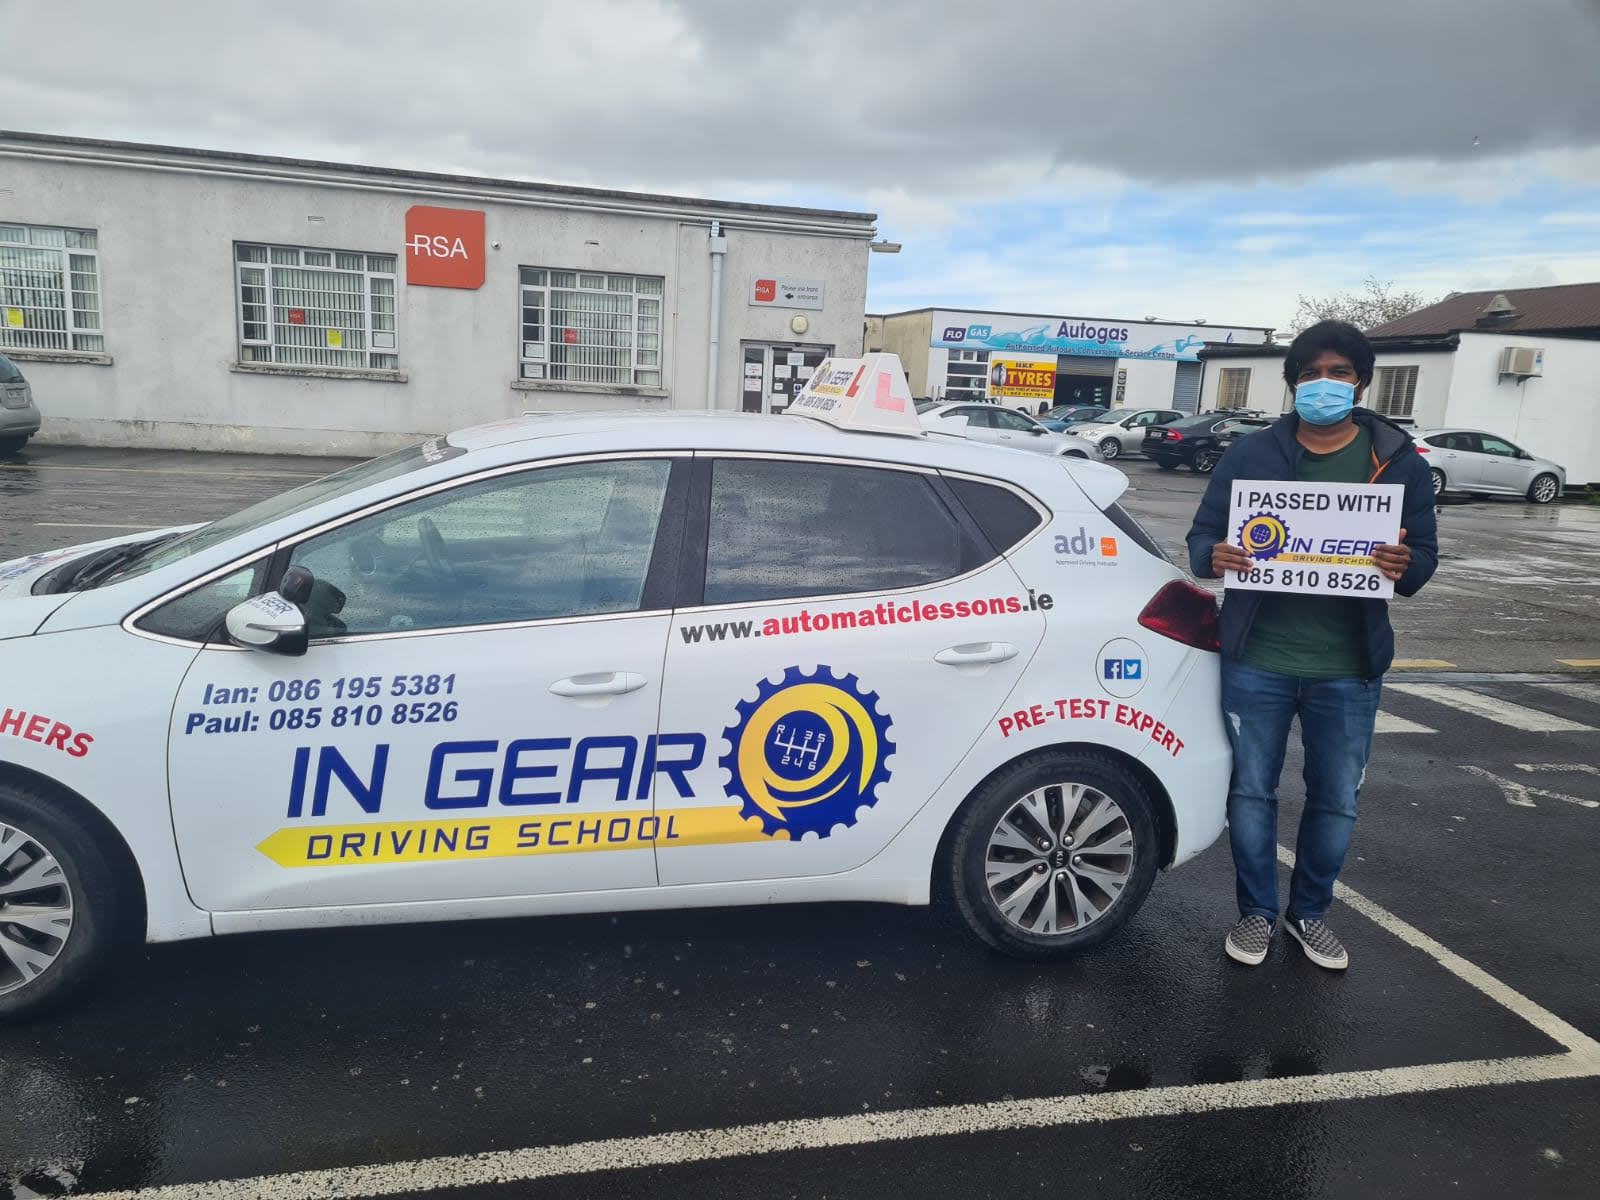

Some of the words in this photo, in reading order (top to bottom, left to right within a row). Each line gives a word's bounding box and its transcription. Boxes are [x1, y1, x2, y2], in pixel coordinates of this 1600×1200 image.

[411, 233, 469, 260] RSA
[945, 330, 963, 339] FLO
[969, 328, 989, 337] GAS
[1056, 320, 1129, 344] Autogas
[1005, 342, 1045, 352] Authorised
[1045, 344, 1075, 354] Autogas
[1077, 346, 1117, 356] Conversion
[1125, 349, 1151, 358] Service
[1152, 350, 1176, 359] Centre
[1007, 370, 1052, 387] TYRES
[874, 372, 905, 411] L
[1237, 491, 1242, 507] I
[1249, 491, 1330, 511] PASSED
[1337, 494, 1392, 513] WITH
[1290, 537, 1314, 553] IN
[1292, 554, 1332, 563] DRIVING
[1337, 557, 1377, 566] SCHOO
[1237, 567, 1275, 585] 085
[1281, 569, 1319, 588] 810
[1327, 572, 1381, 591] 8526
[680, 588, 1054, 644] www.automaticlessons.ie
[202, 683, 259, 705] Ian:
[268, 678, 322, 702] 086
[332, 676, 382, 699] 195
[390, 673, 456, 697] 5381
[185, 710, 260, 735] Paul:
[269, 707, 322, 731] 085
[330, 704, 383, 728] 810
[390, 701, 459, 725] 8526
[998, 698, 1110, 738] PRE-TEST
[1114, 703, 1185, 758] EXPERT
[0, 708, 94, 758] HERS
[776, 724, 785, 734] R
[804, 730, 813, 740] 3
[817, 733, 826, 742] 5
[781, 755, 790, 765] 2
[807, 761, 816, 770] 6
[287, 743, 390, 818] IN
[424, 732, 707, 810] GEAR
[307, 825, 491, 860] DRIVING
[517, 815, 680, 848] SCHOOL
